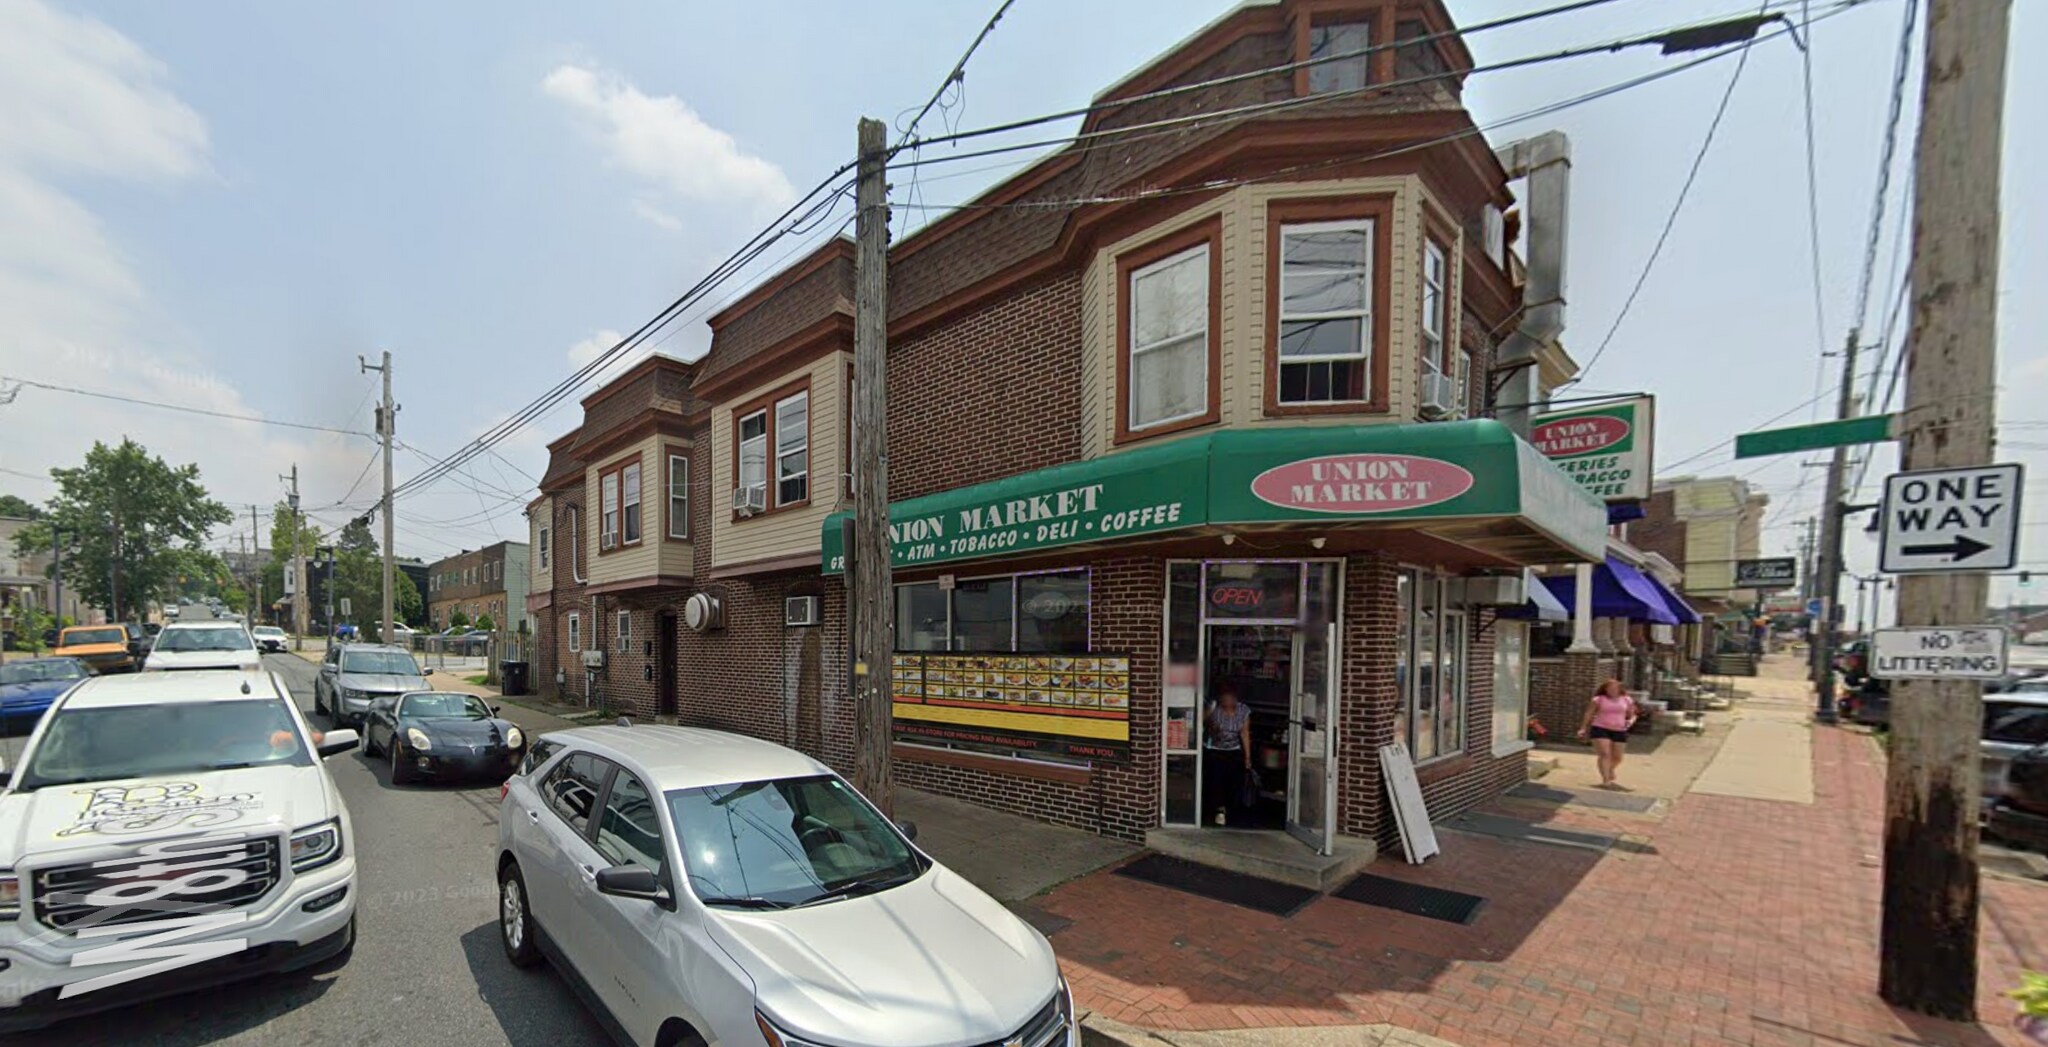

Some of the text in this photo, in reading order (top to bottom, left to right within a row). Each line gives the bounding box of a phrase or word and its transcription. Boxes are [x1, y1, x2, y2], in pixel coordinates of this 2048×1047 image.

[1545, 422, 1598, 439] UNION
[1310, 460, 1409, 481] UNION
[1572, 469, 1632, 484] BACCO
[1290, 481, 1433, 504] MARKET
[1902, 475, 2002, 504] ONE
[886, 484, 1104, 546] NION MARKET
[1898, 503, 2003, 532] WAY
[907, 545, 935, 561] ATM
[950, 530, 1018, 555] TOBACCO
[1037, 521, 1079, 542] DELI
[1100, 503, 1182, 533] COFFEE
[1212, 588, 1264, 605] OPEN
[1921, 633, 1952, 650] NO
[1878, 656, 1998, 672] LITTERING
[981, 734, 995, 742] AND
[1069, 745, 1095, 755] THANK
